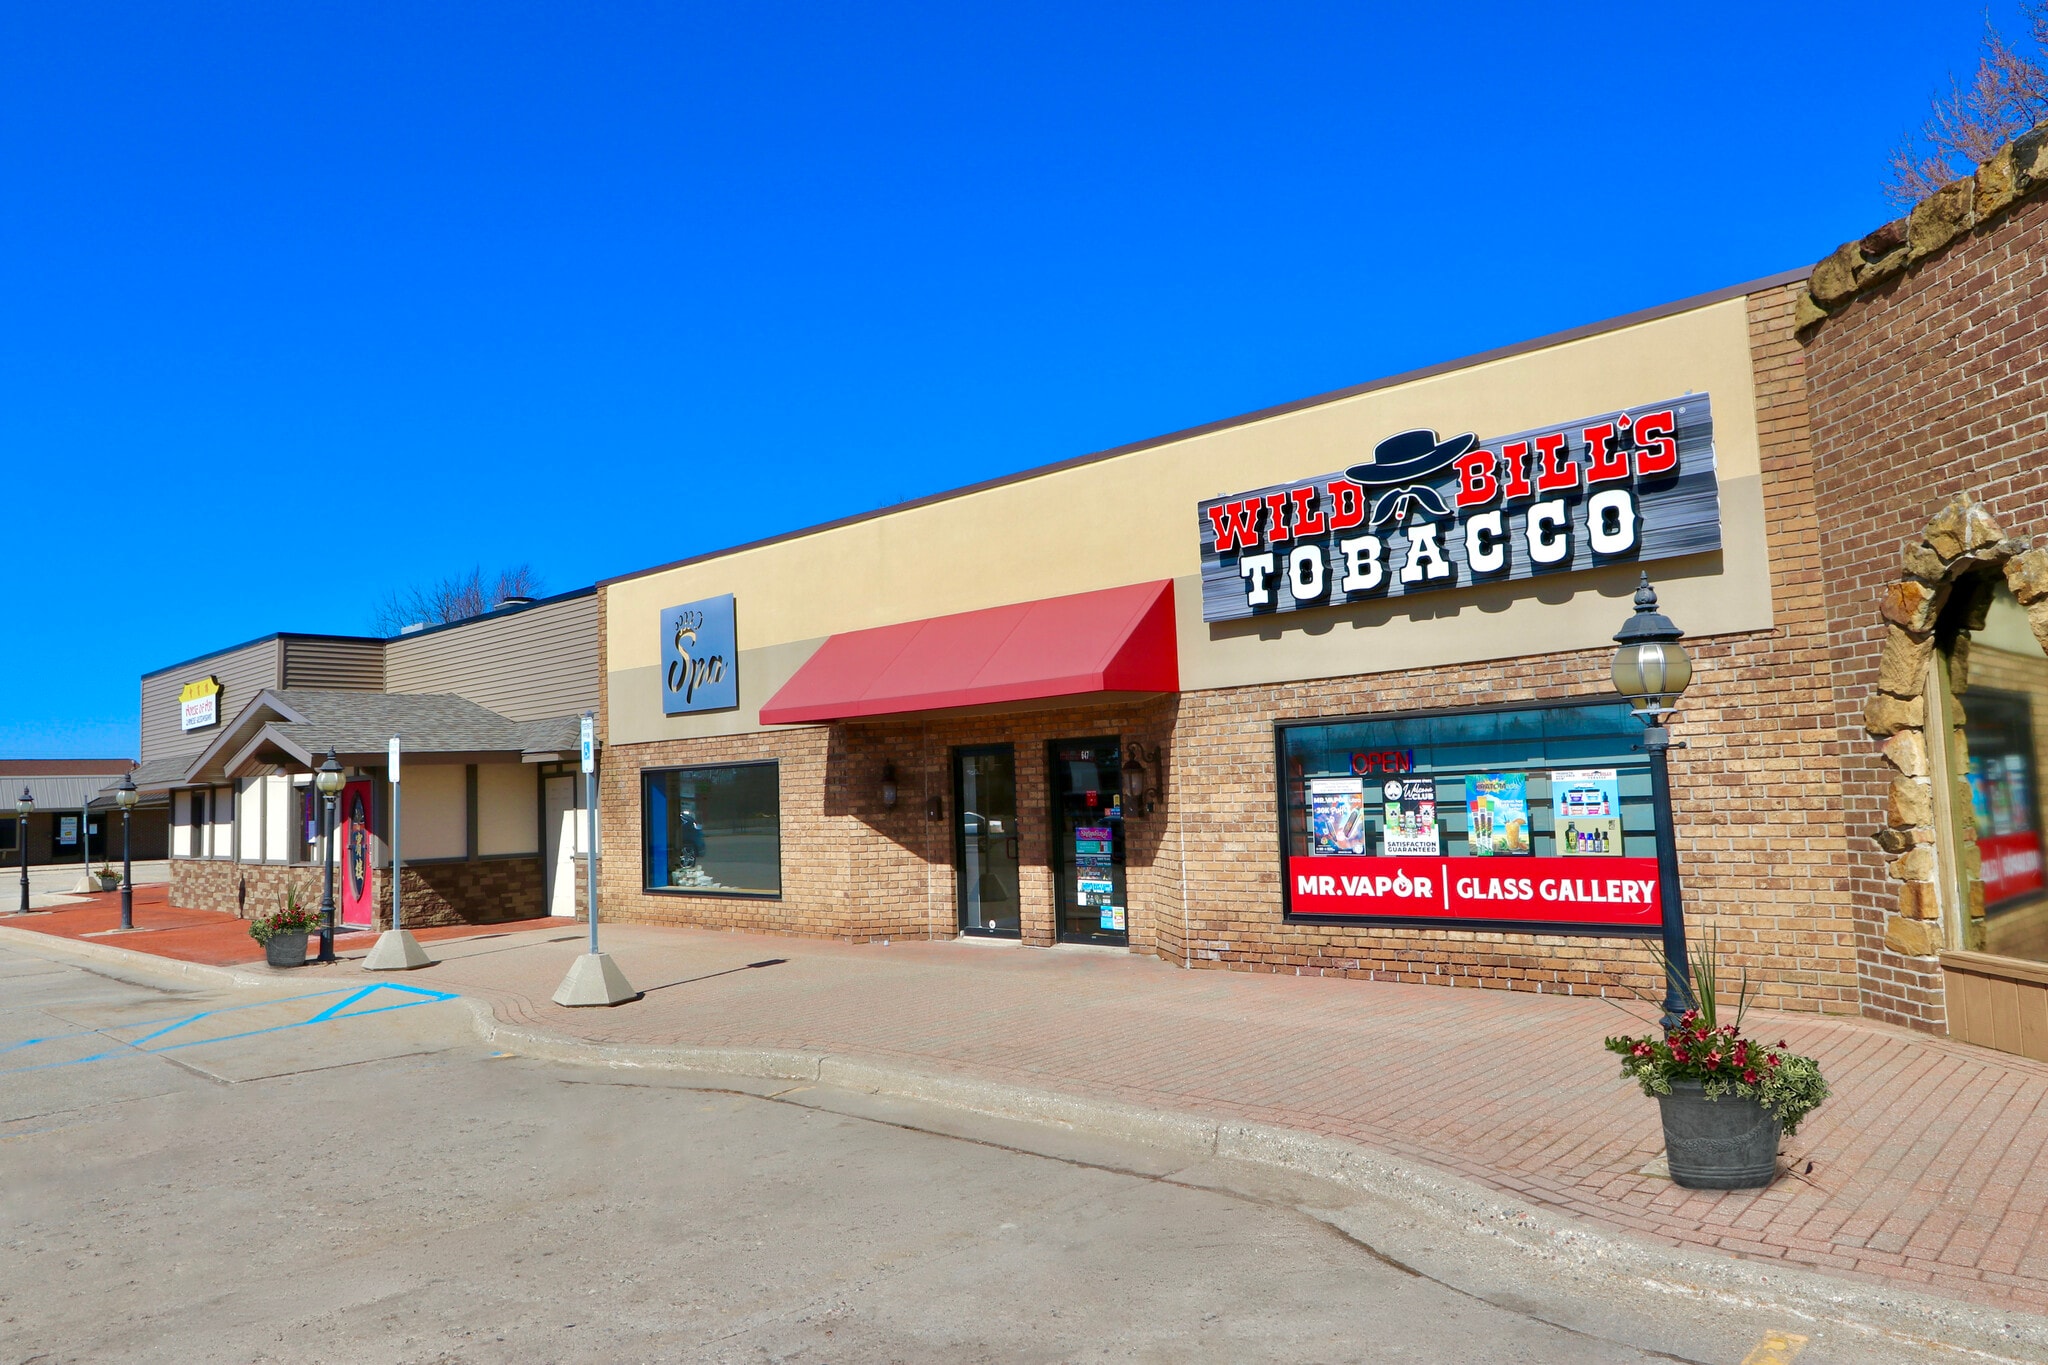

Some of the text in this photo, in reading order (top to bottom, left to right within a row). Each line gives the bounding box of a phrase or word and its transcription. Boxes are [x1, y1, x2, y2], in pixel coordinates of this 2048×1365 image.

[1207, 408, 1677, 553] WILD BILL'S
[1239, 488, 1638, 607] TOBACCO
[667, 626, 729, 705] Spa
[1081, 750, 1090, 760] 647
[1352, 751, 1410, 775] OPEN
[1297, 868, 1433, 898] MR.VAPOR
[1456, 877, 1656, 904] GLASS GALLERY
